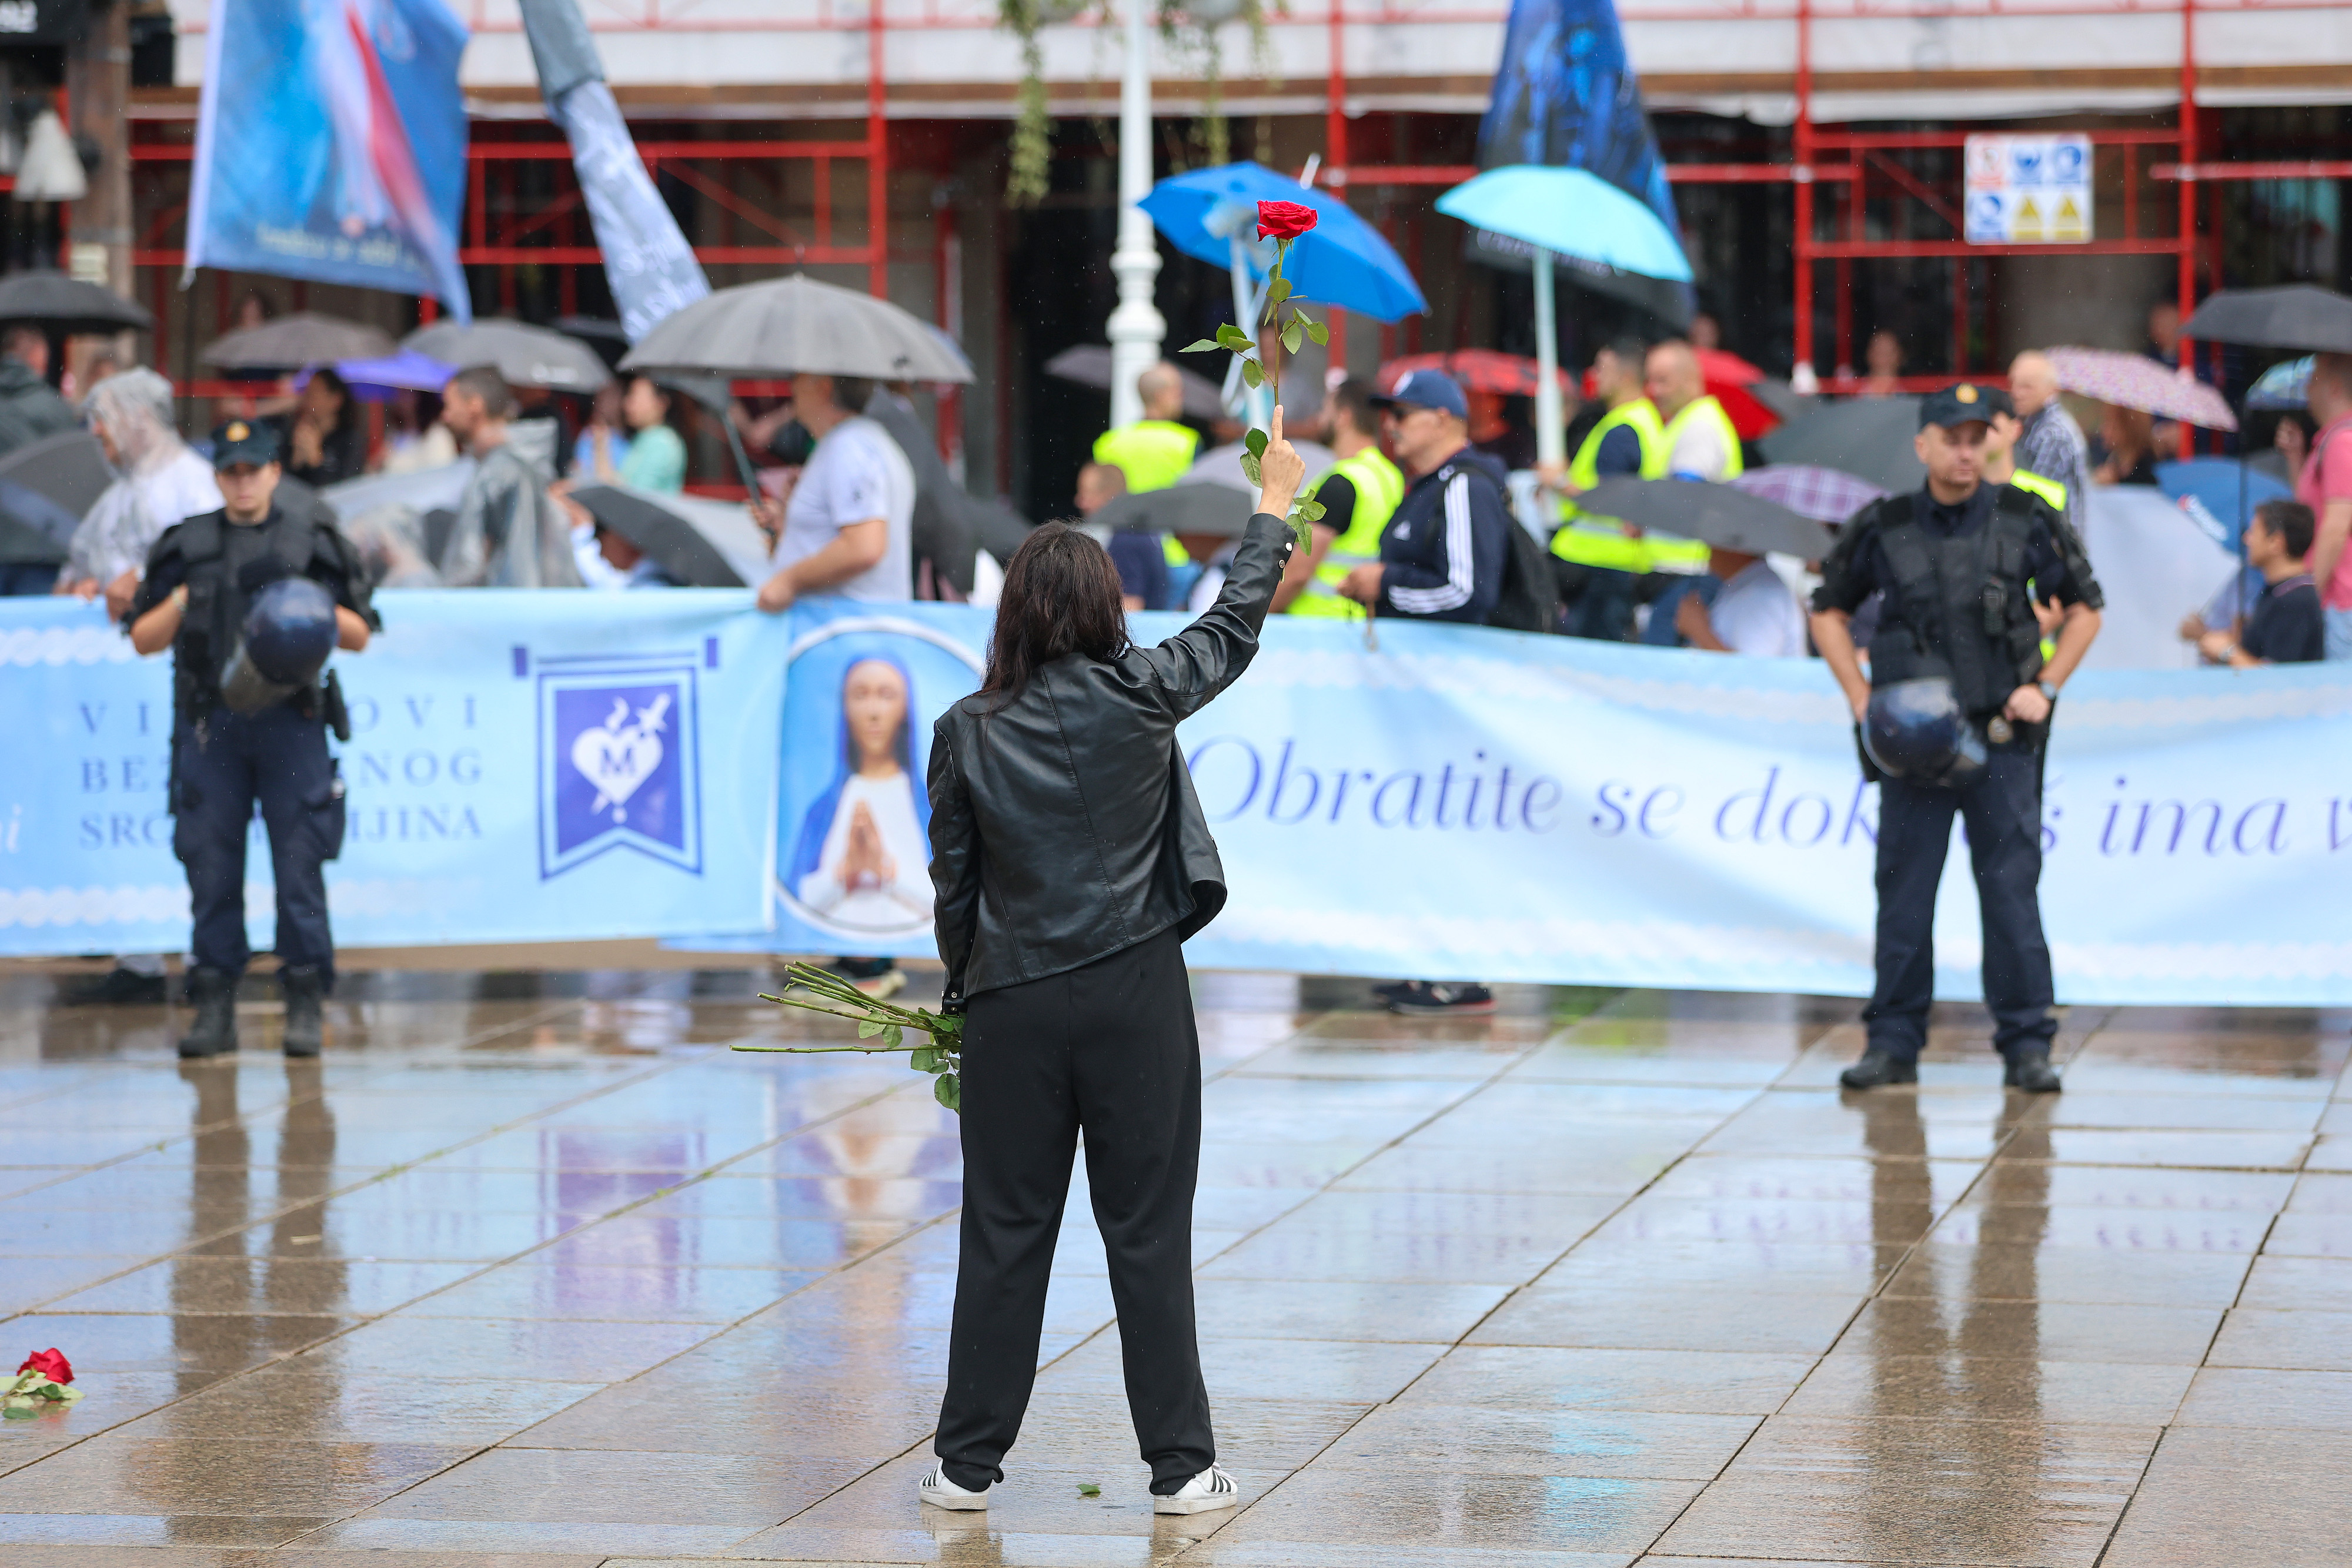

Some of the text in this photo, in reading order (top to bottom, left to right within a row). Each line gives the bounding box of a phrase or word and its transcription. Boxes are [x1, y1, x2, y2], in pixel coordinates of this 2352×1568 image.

[600, 744, 636, 780] M
[1185, 734, 1563, 835] Obratite
[1589, 778, 1685, 840] se
[2098, 775, 2289, 857] ima
